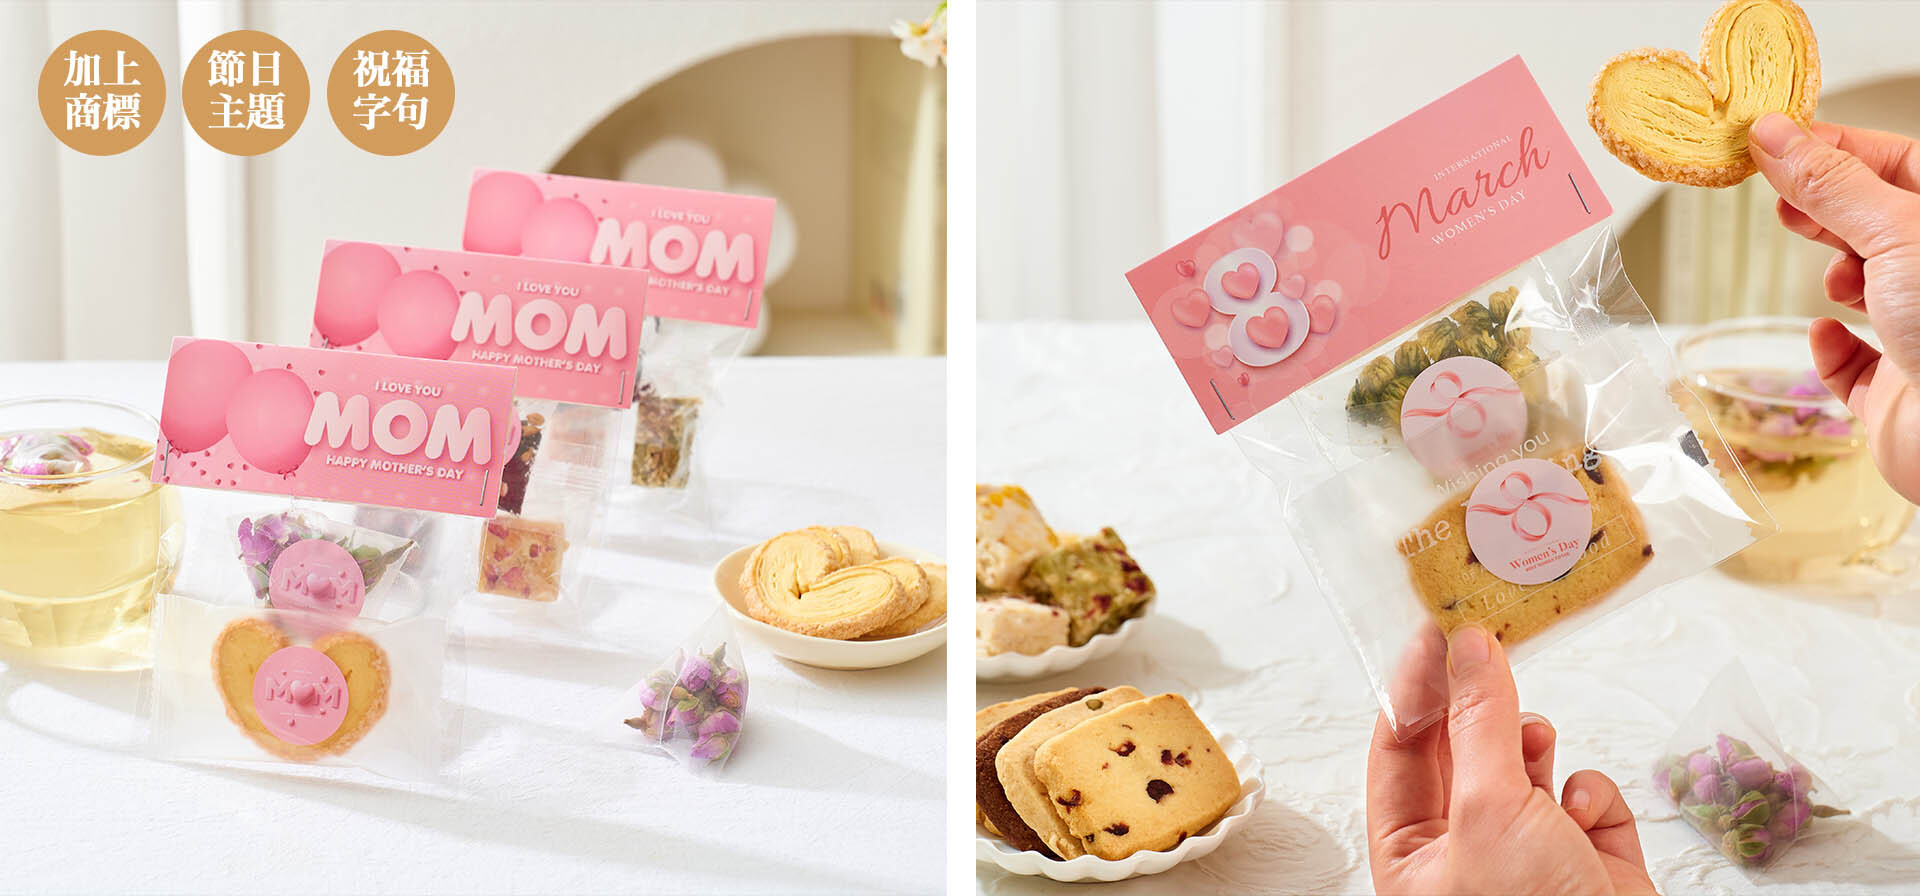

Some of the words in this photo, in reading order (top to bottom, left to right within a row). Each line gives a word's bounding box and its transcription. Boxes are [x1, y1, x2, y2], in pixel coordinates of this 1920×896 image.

[1433, 135, 1513, 181] INTERNATIONAL
[1375, 126, 1550, 260] March
[657, 208, 684, 221] LOVE
[686, 211, 711, 225] YOU
[1431, 207, 1497, 245] WOMEN'S
[1498, 190, 1526, 211] DAY
[590, 218, 755, 283] MOM
[523, 282, 551, 294] LOVE
[554, 284, 580, 297] YOU
[705, 284, 730, 296] DAY
[1204, 247, 1310, 367] 8
[451, 291, 627, 360] MOM
[472, 350, 512, 363] HAPPY
[513, 354, 574, 370] MOTHER'S
[576, 361, 602, 374] DAY
[382, 381, 412, 394] LOVE
[415, 384, 441, 397] YOU
[304, 392, 491, 465] MOM
[1512, 431, 1550, 459] you
[326, 454, 368, 468] HAPPY
[370, 460, 434, 477] MOTHER'S
[437, 467, 464, 480] DAY
[1509, 547, 1557, 569] Women's
[1558, 539, 1579, 552] Day
